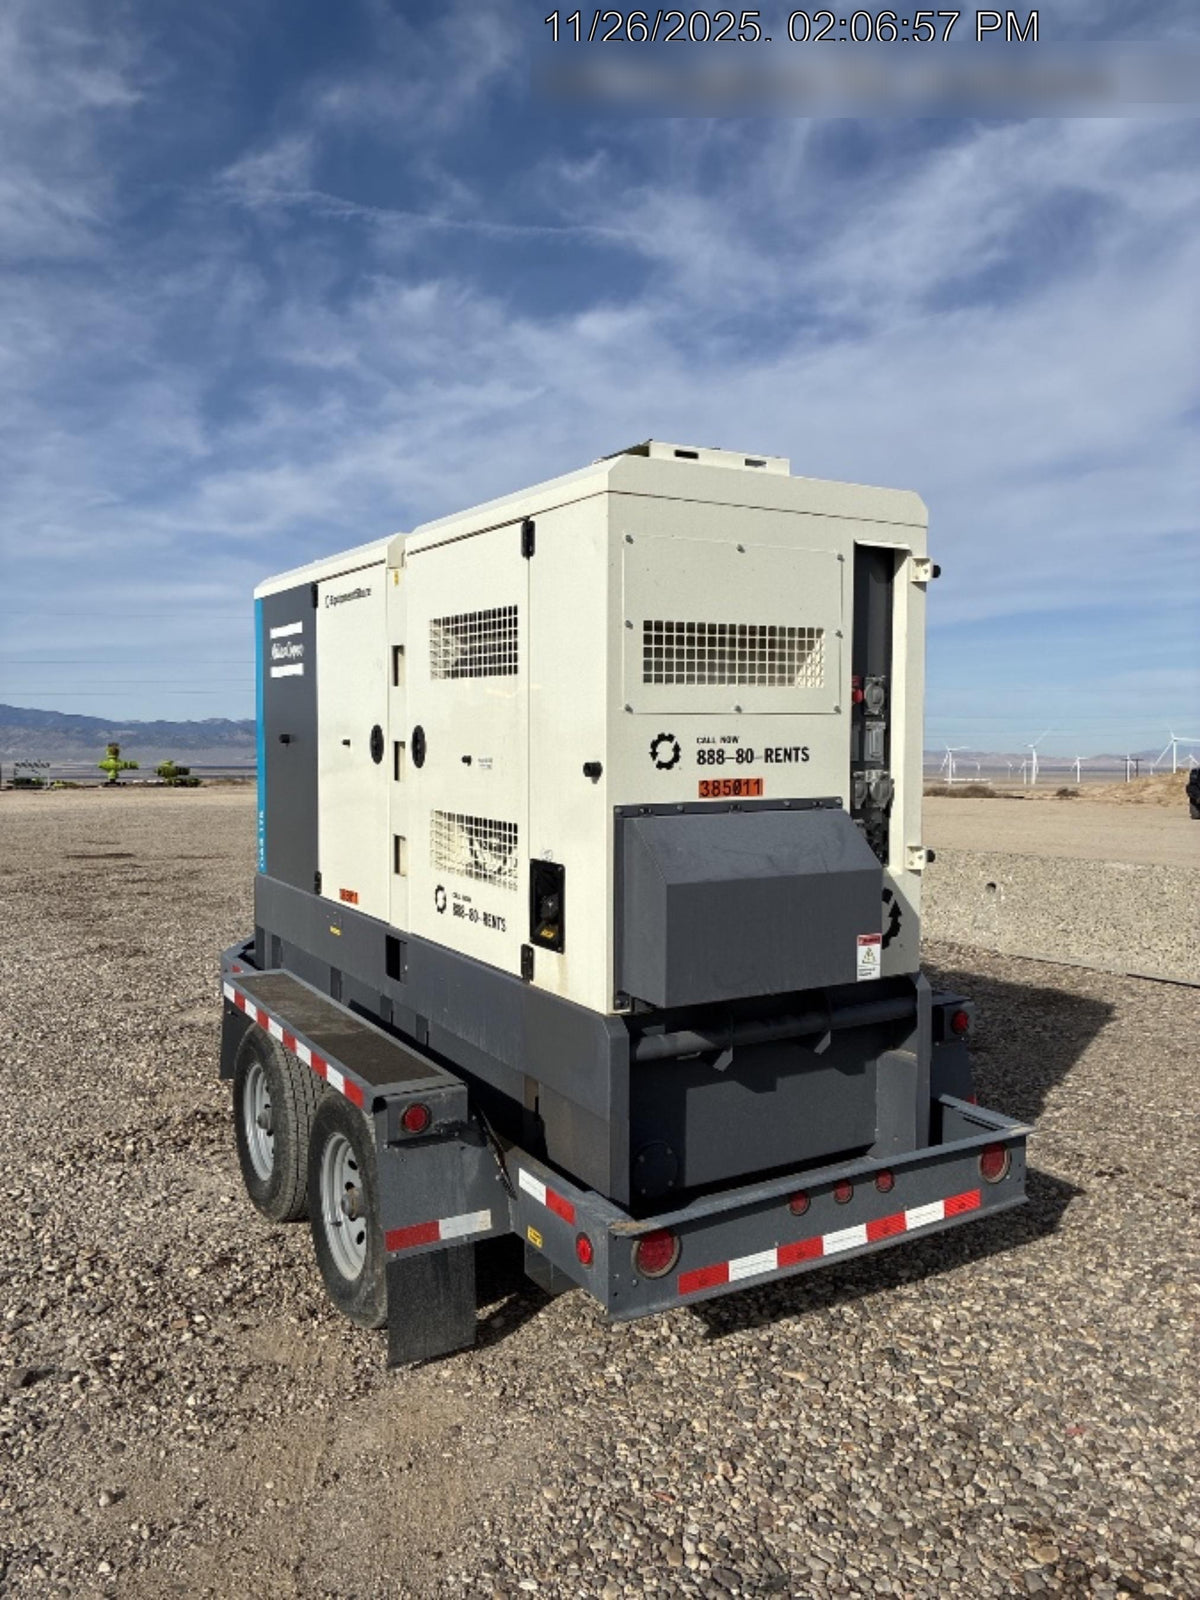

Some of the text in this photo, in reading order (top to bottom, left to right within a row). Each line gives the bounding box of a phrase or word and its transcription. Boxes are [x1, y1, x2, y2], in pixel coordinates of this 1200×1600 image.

[696, 735, 740, 744] CALL NOW
[696, 746, 810, 766] 888-80-RENTS
[700, 779, 761, 797] 385011
